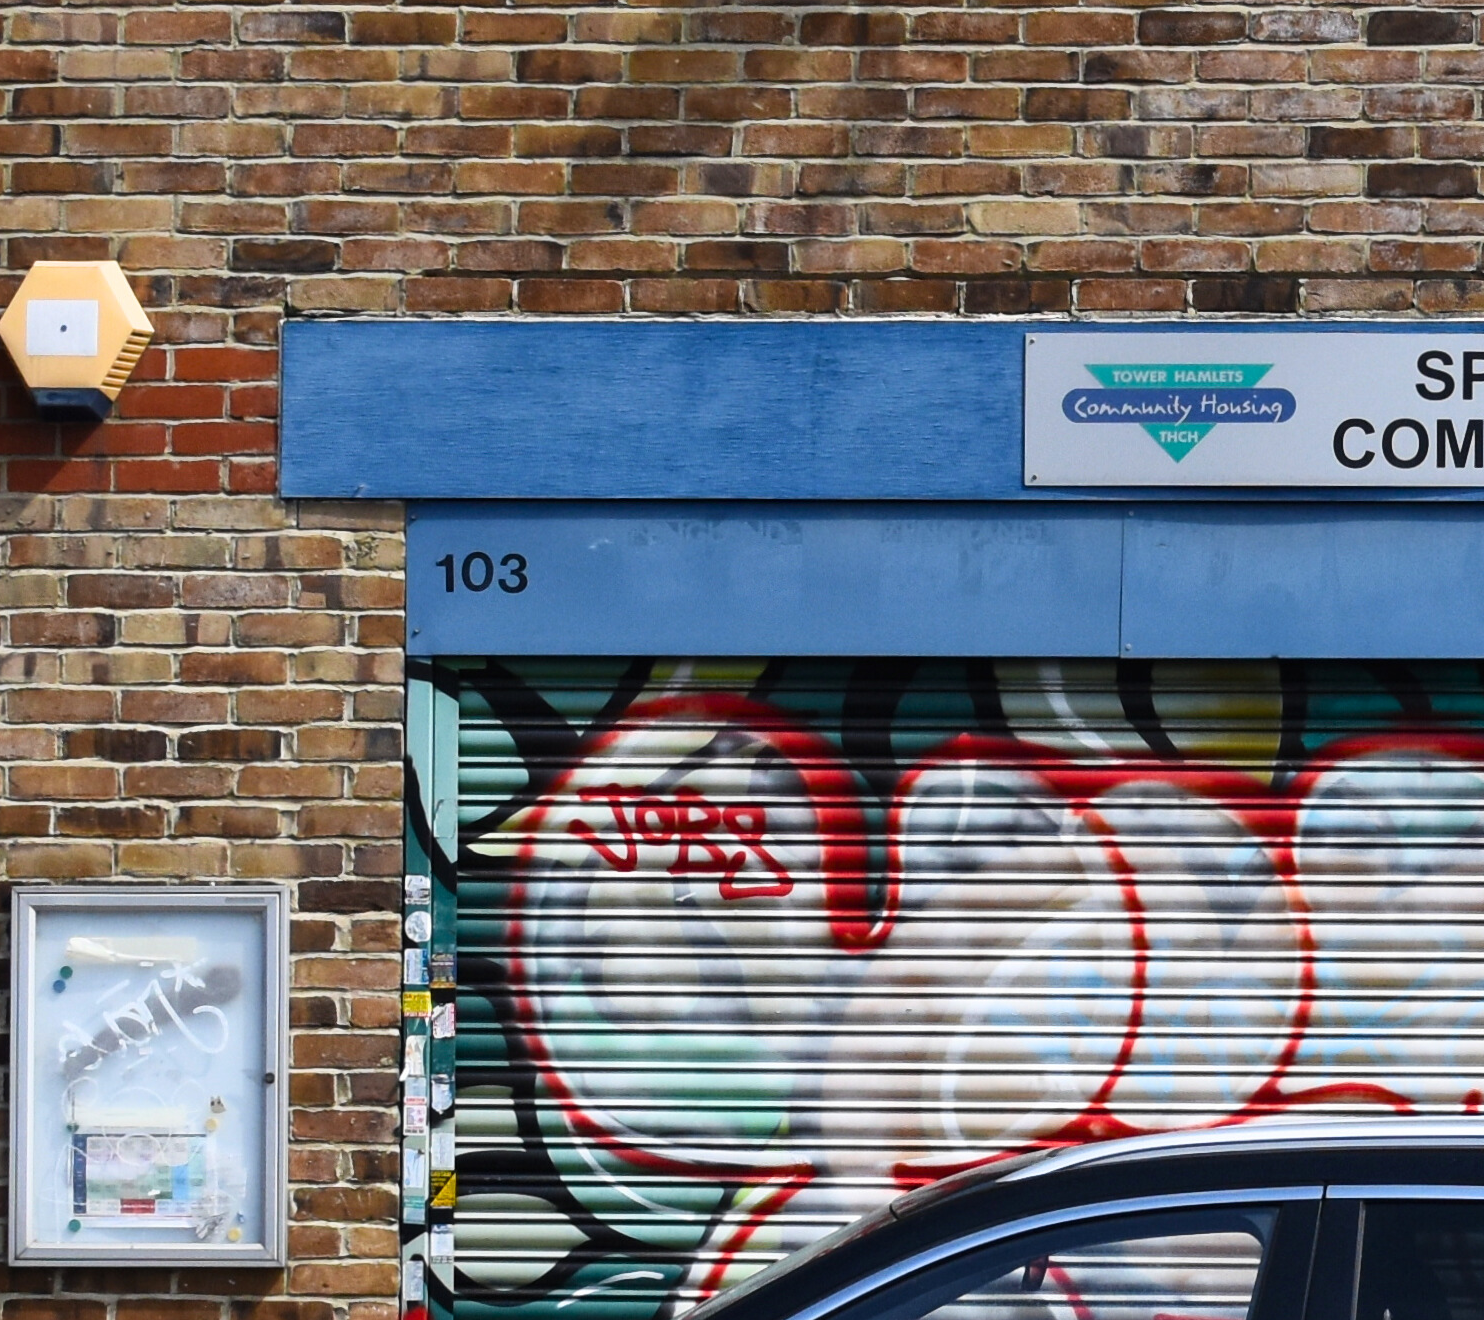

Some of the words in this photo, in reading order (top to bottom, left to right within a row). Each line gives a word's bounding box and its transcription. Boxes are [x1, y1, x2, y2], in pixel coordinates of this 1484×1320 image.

[1111, 370, 1167, 383] TOWER
[1173, 370, 1244, 383] HAMLETS
[1074, 394, 1192, 427] Community
[1200, 393, 1284, 423] Housing
[1158, 430, 1199, 443] THCH
[434, 551, 529, 594] 103
